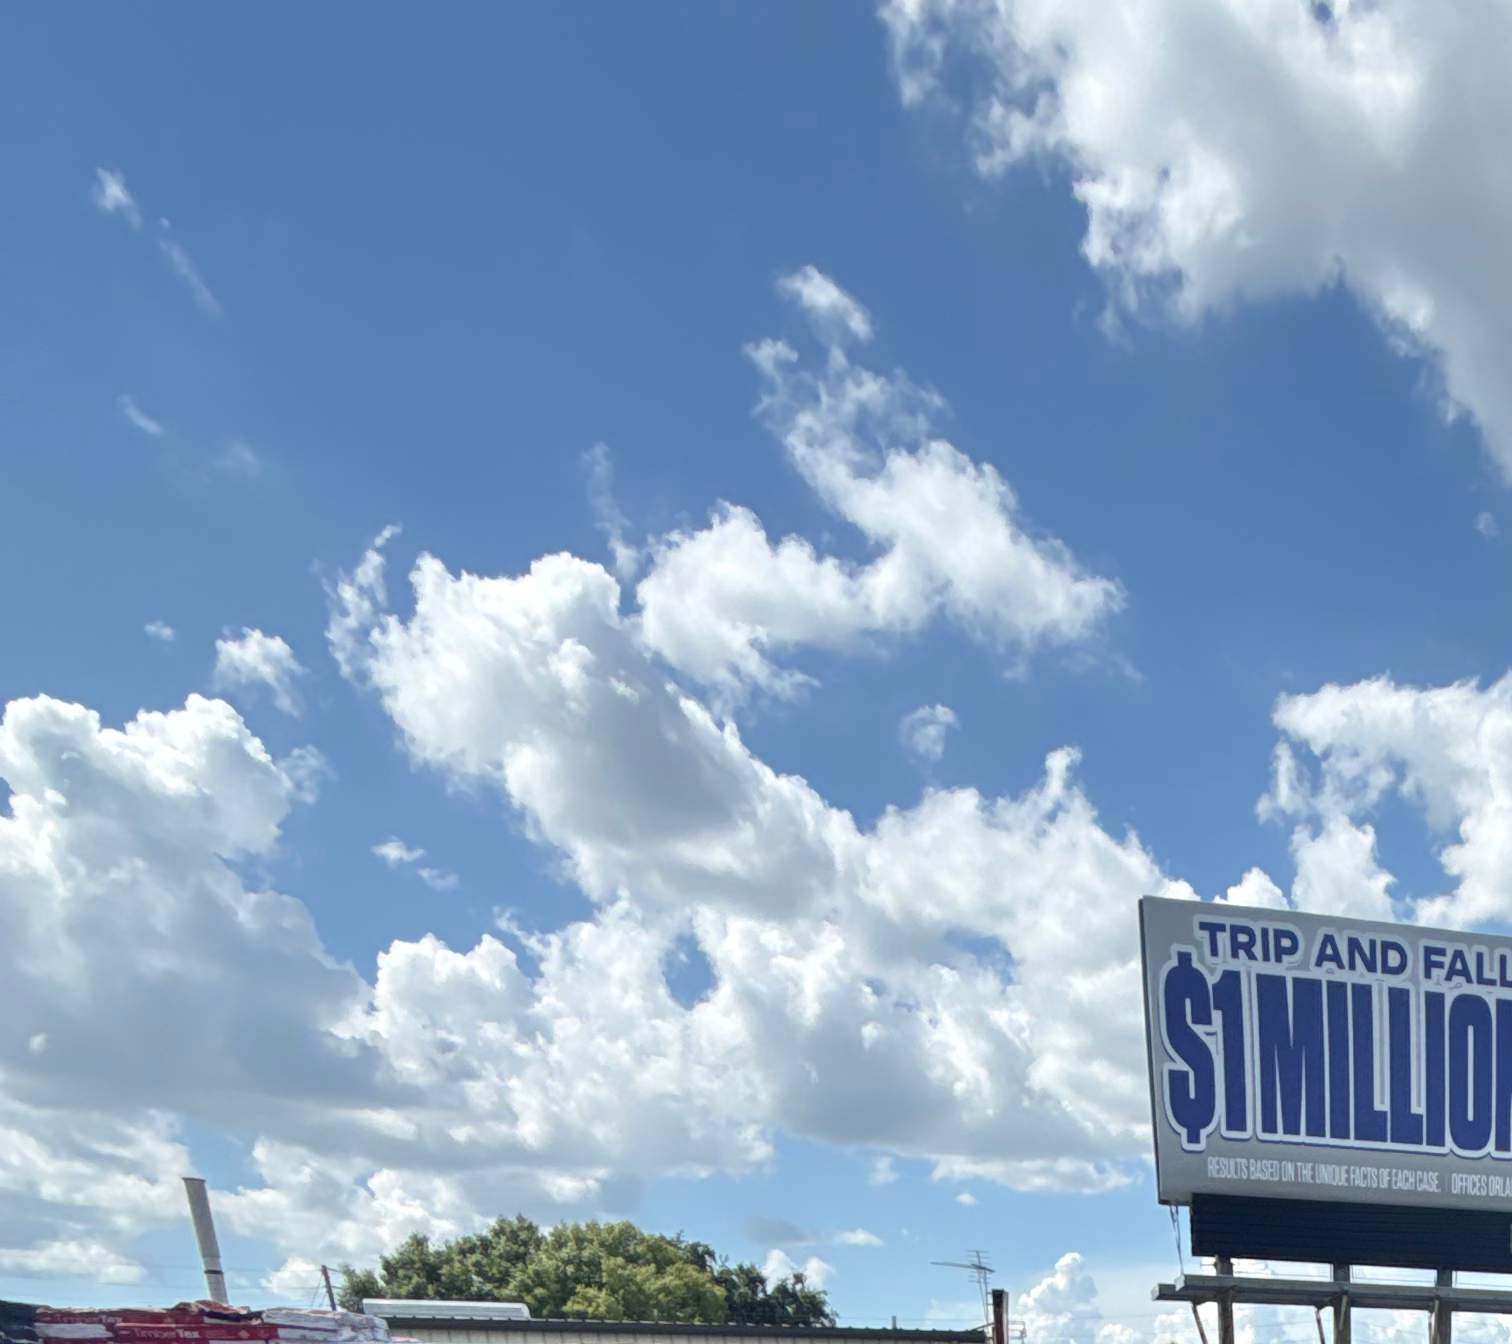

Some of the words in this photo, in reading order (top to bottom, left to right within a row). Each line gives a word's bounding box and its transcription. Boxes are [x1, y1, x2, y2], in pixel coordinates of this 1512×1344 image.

[1198, 921, 1300, 963] TRIP
[1314, 933, 1408, 976] AND
[1207, 1156, 1249, 1179] RESULTS
[1249, 1158, 1280, 1182] BASED
[1281, 1160, 1295, 1183] ON
[1295, 1162, 1313, 1184] THE
[1315, 1163, 1349, 1187] UNIQUE
[1350, 1166, 1378, 1189] FACTS
[1379, 1168, 1391, 1189] OF
[1391, 1169, 1416, 1191] EACH
[1416, 1171, 1441, 1193] CASE.
[1451, 1173, 1488, 1197] OFFICES
